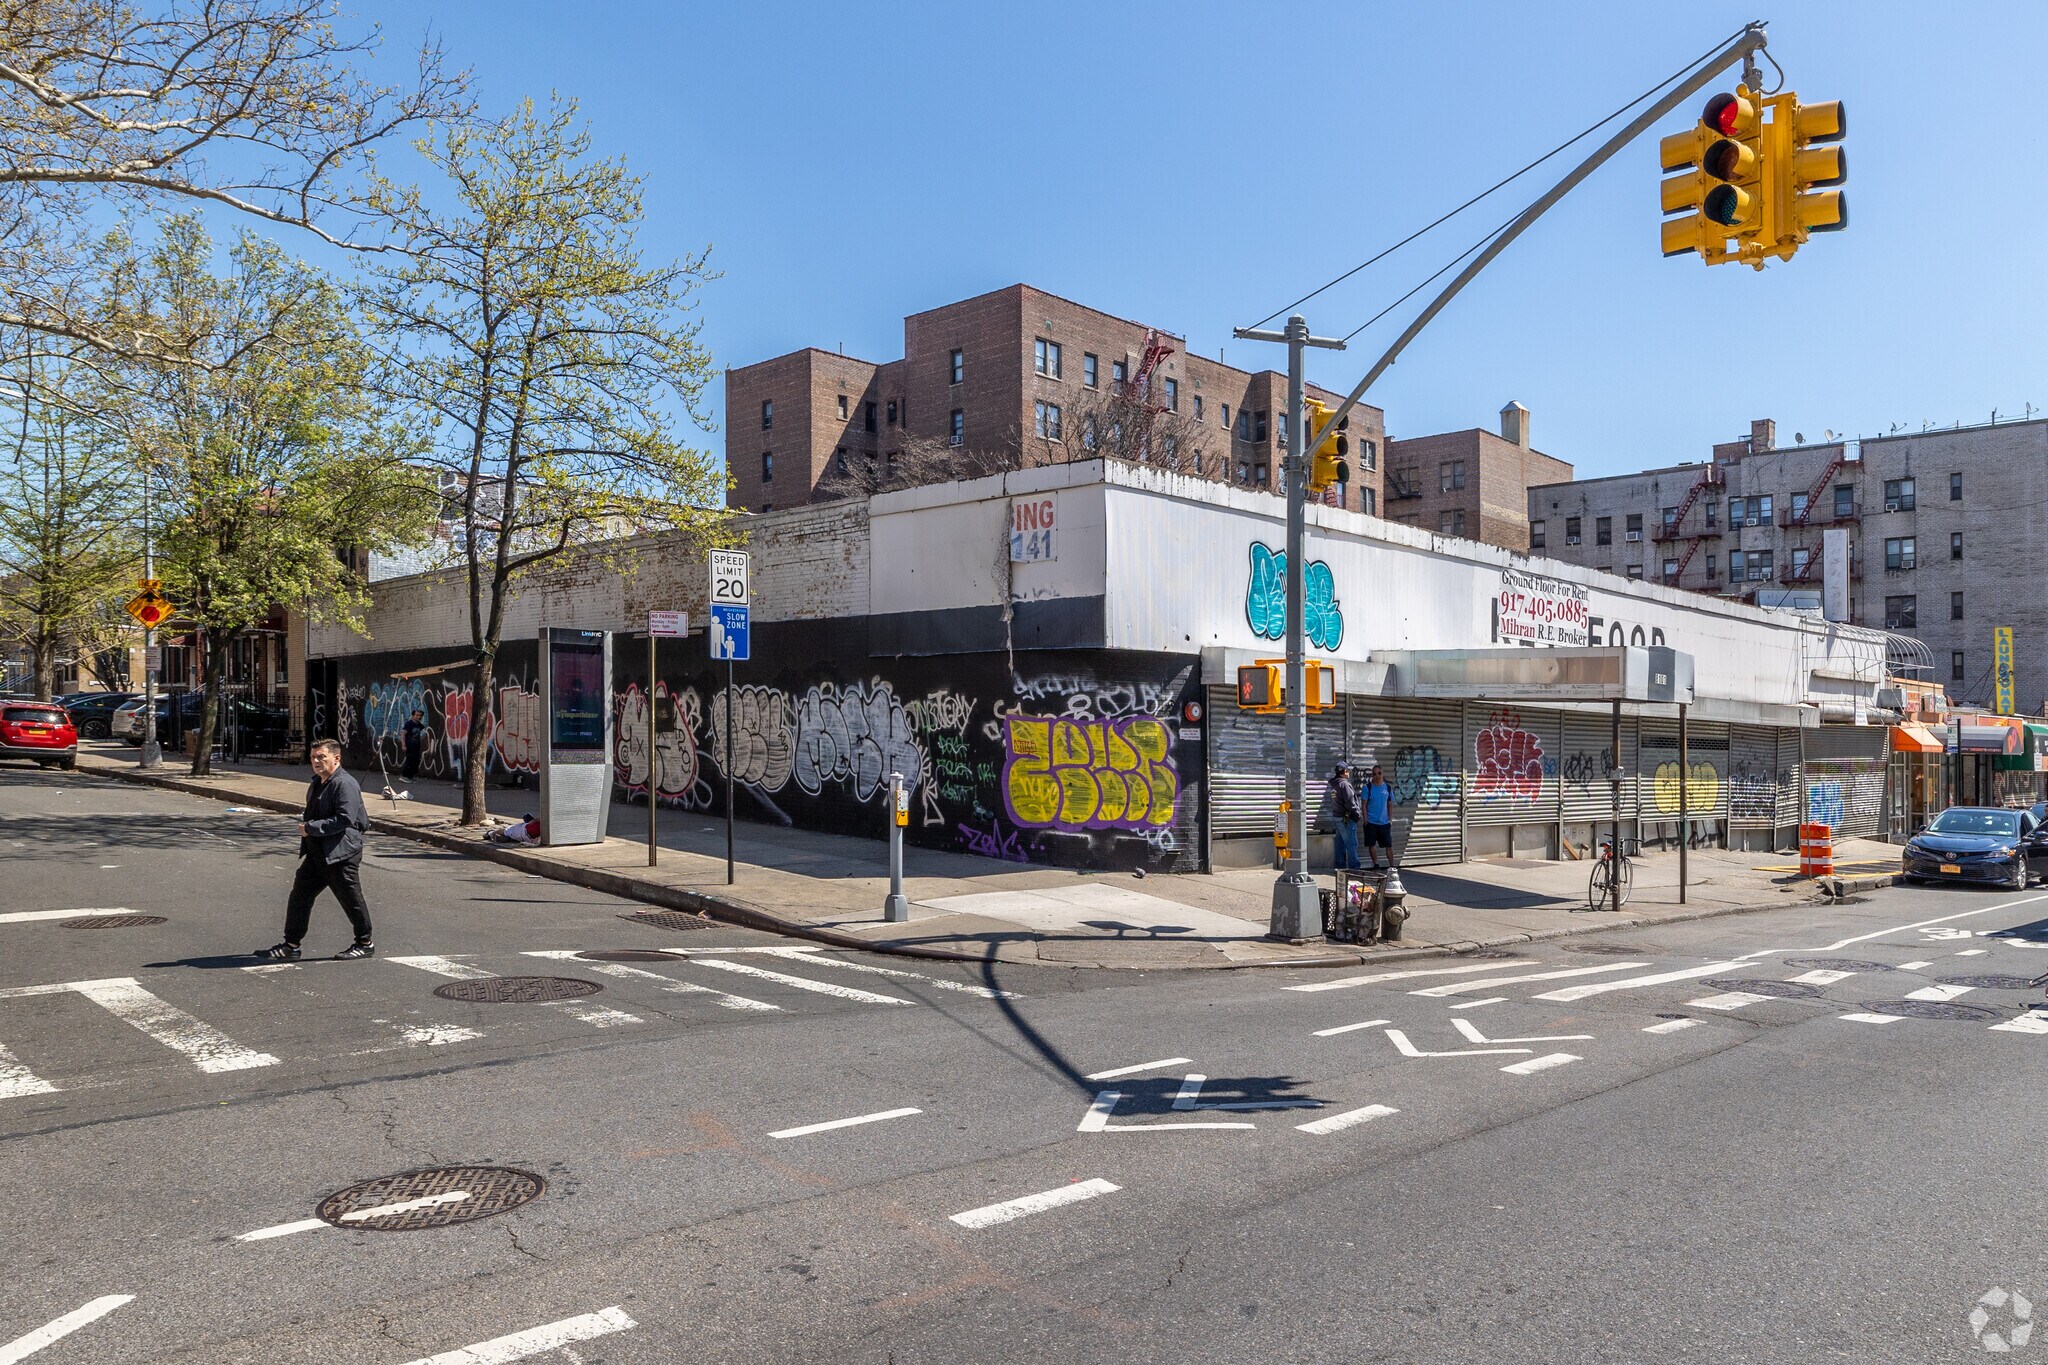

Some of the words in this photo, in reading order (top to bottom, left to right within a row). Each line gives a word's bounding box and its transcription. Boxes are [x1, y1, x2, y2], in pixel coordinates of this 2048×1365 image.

[714, 555, 744, 566] SPEED
[716, 566, 743, 576] LIMIT
[716, 578, 744, 598] 20
[1502, 569, 1533, 590] Ground
[1535, 575, 1556, 594] Floor
[1557, 581, 1571, 597] For
[1572, 585, 1589, 601] Rent
[726, 612, 746, 621] SLOW
[1501, 591, 1588, 629] 917.405.0885
[726, 620, 746, 629] ZONE
[1500, 617, 1536, 638] Mihran
[1537, 623, 1555, 641] R.E.
[1558, 627, 1587, 646] Broker
